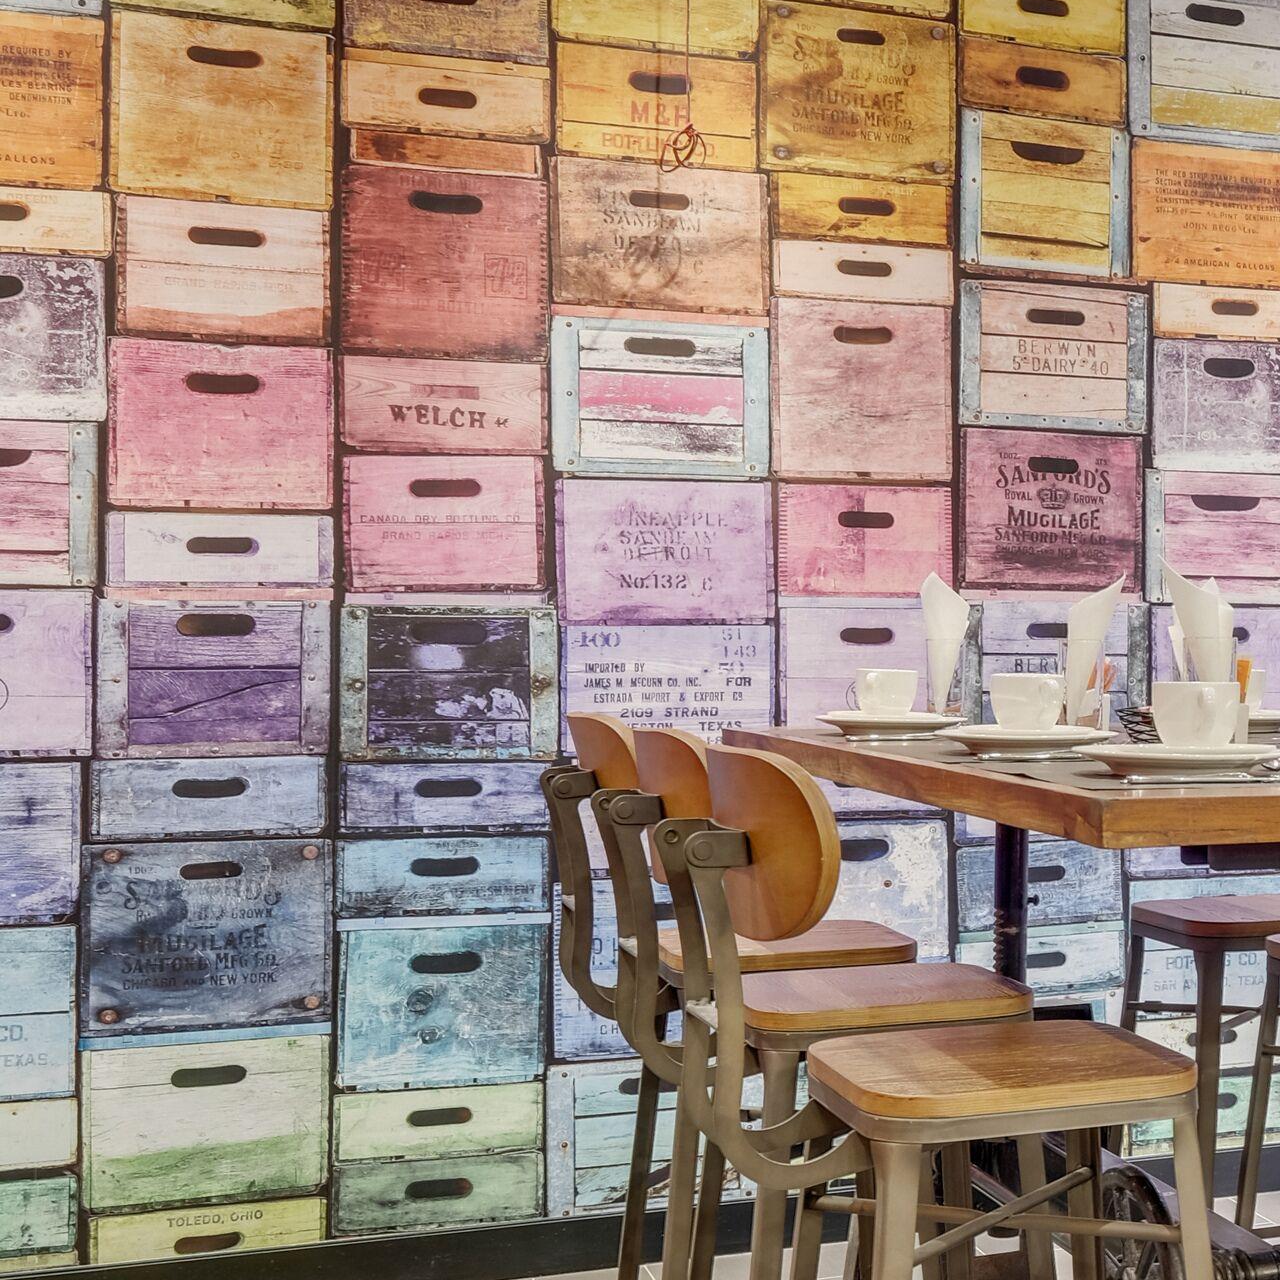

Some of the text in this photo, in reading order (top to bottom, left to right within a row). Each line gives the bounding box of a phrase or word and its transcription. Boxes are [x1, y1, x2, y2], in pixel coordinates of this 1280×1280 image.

[1, 44, 72, 59] REQUIRED BY
[860, 131, 882, 142] NEW
[1183, 222, 1208, 231] JOHN
[1184, 257, 1230, 269] AMERICAN
[1235, 261, 1276, 272] GALLONS
[1018, 339, 1097, 358] BERWYN
[389, 404, 487, 429] WELCH
[1004, 488, 1033, 501] ROYAL
[360, 514, 407, 524] CANADA
[382, 531, 422, 541] GRAND
[994, 526, 1059, 544] SANFORD
[623, 546, 713, 561] DETROIT
[585, 662, 645, 673] IMPORTED BY
[583, 677, 612, 689] JAMES
[726, 677, 752, 687] FOR
[593, 692, 633, 704] ESTRADA
[641, 692, 671, 703] IMPORT
[693, 691, 725, 702] EXPORT
[620, 706, 719, 719] 2109 STRAND
[699, 721, 743, 731] TEXAS
[210, 974, 239, 986] NEW
[1237, 975, 1265, 986] TEXA
[166, 1209, 265, 1228] TOLEDO, OHIO
